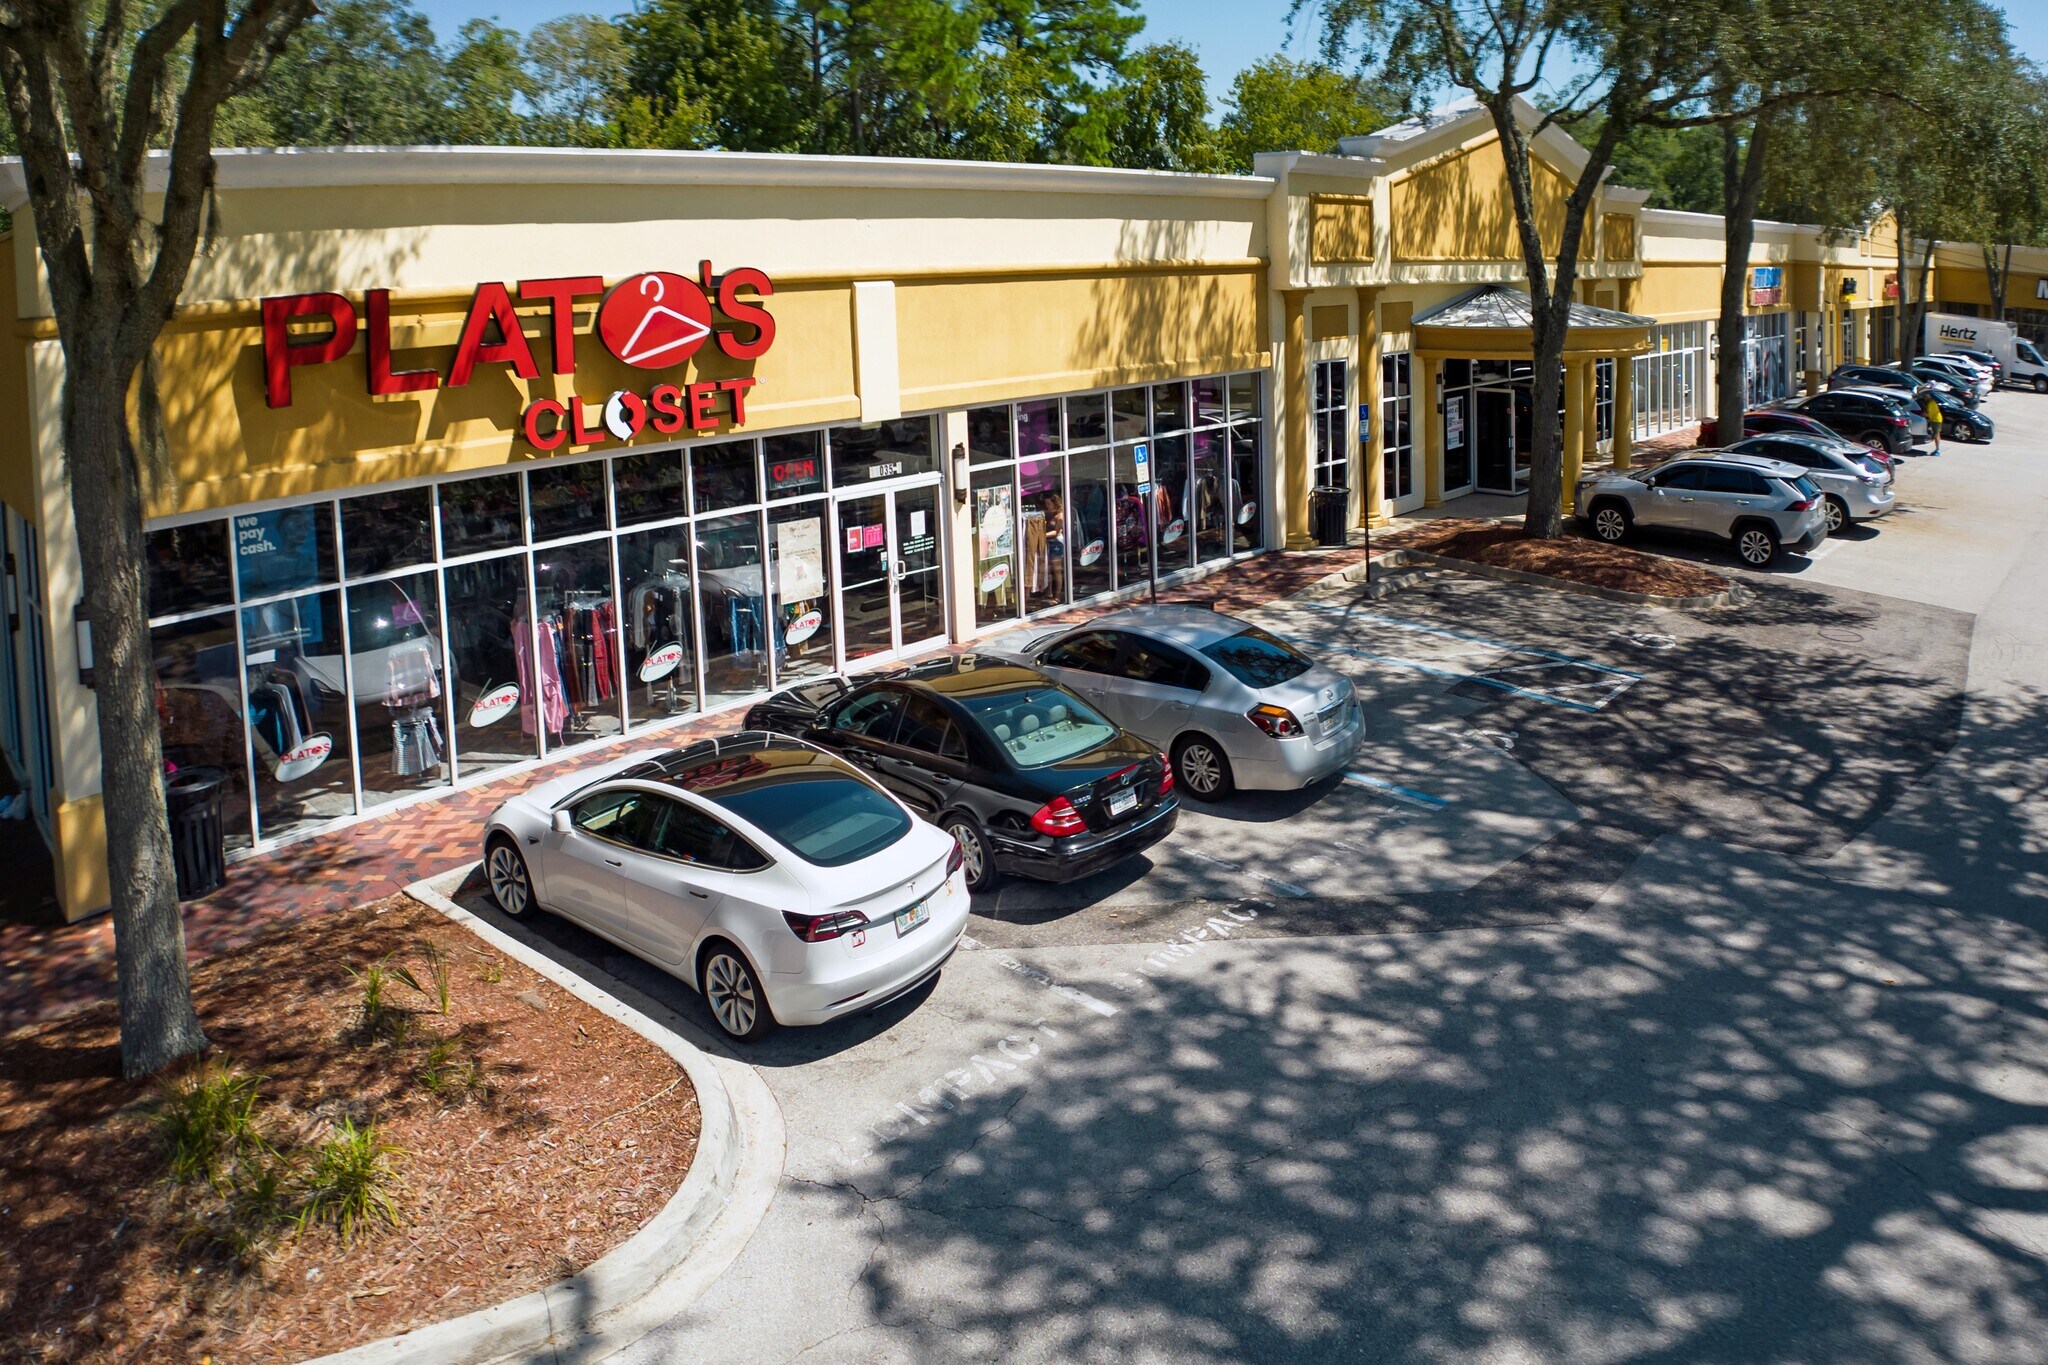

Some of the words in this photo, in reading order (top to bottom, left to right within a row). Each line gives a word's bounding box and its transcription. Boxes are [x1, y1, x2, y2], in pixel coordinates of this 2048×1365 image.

[261, 259, 776, 409] PLATO'S
[1940, 324, 1977, 340] Hertz
[525, 377, 756, 451] CLOSET
[773, 460, 814, 481] OPEN
[237, 516, 258, 528] we
[238, 527, 265, 544] pay
[240, 540, 277, 555] cash.
